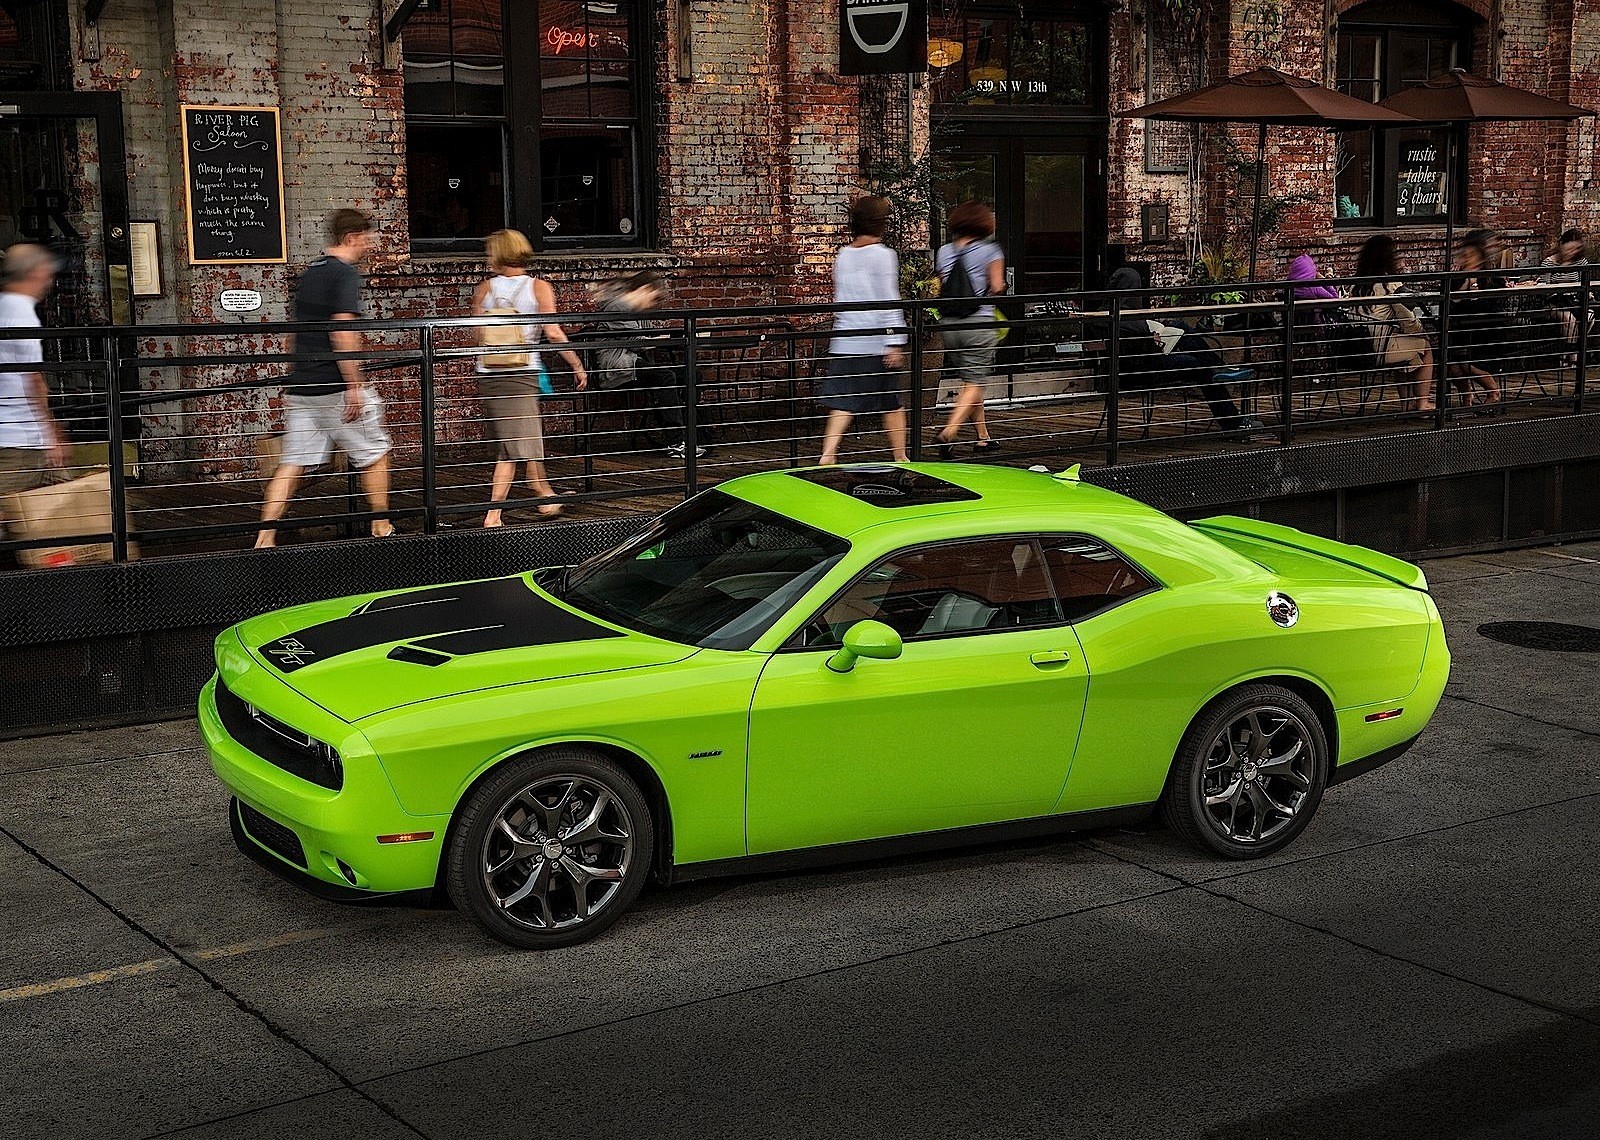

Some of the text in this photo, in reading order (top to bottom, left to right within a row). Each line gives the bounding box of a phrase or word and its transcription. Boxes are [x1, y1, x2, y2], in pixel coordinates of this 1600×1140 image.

[547, 25, 598, 55] Open
[976, 80, 994, 92] 539
[1027, 81, 1048, 93] 13th
[194, 113, 259, 127] RIVER PIG
[207, 125, 248, 143] Saloon
[1407, 144, 1437, 162] rustic
[1406, 165, 1437, 183] tables
[233, 180, 248, 189] but
[250, 181, 259, 190] it
[1399, 186, 1442, 205] & chairs
[197, 206, 223, 216] which
[224, 207, 230, 215] is
[199, 220, 222, 228] much
[224, 219, 238, 228] the
[268, 637, 316, 665] R/T
